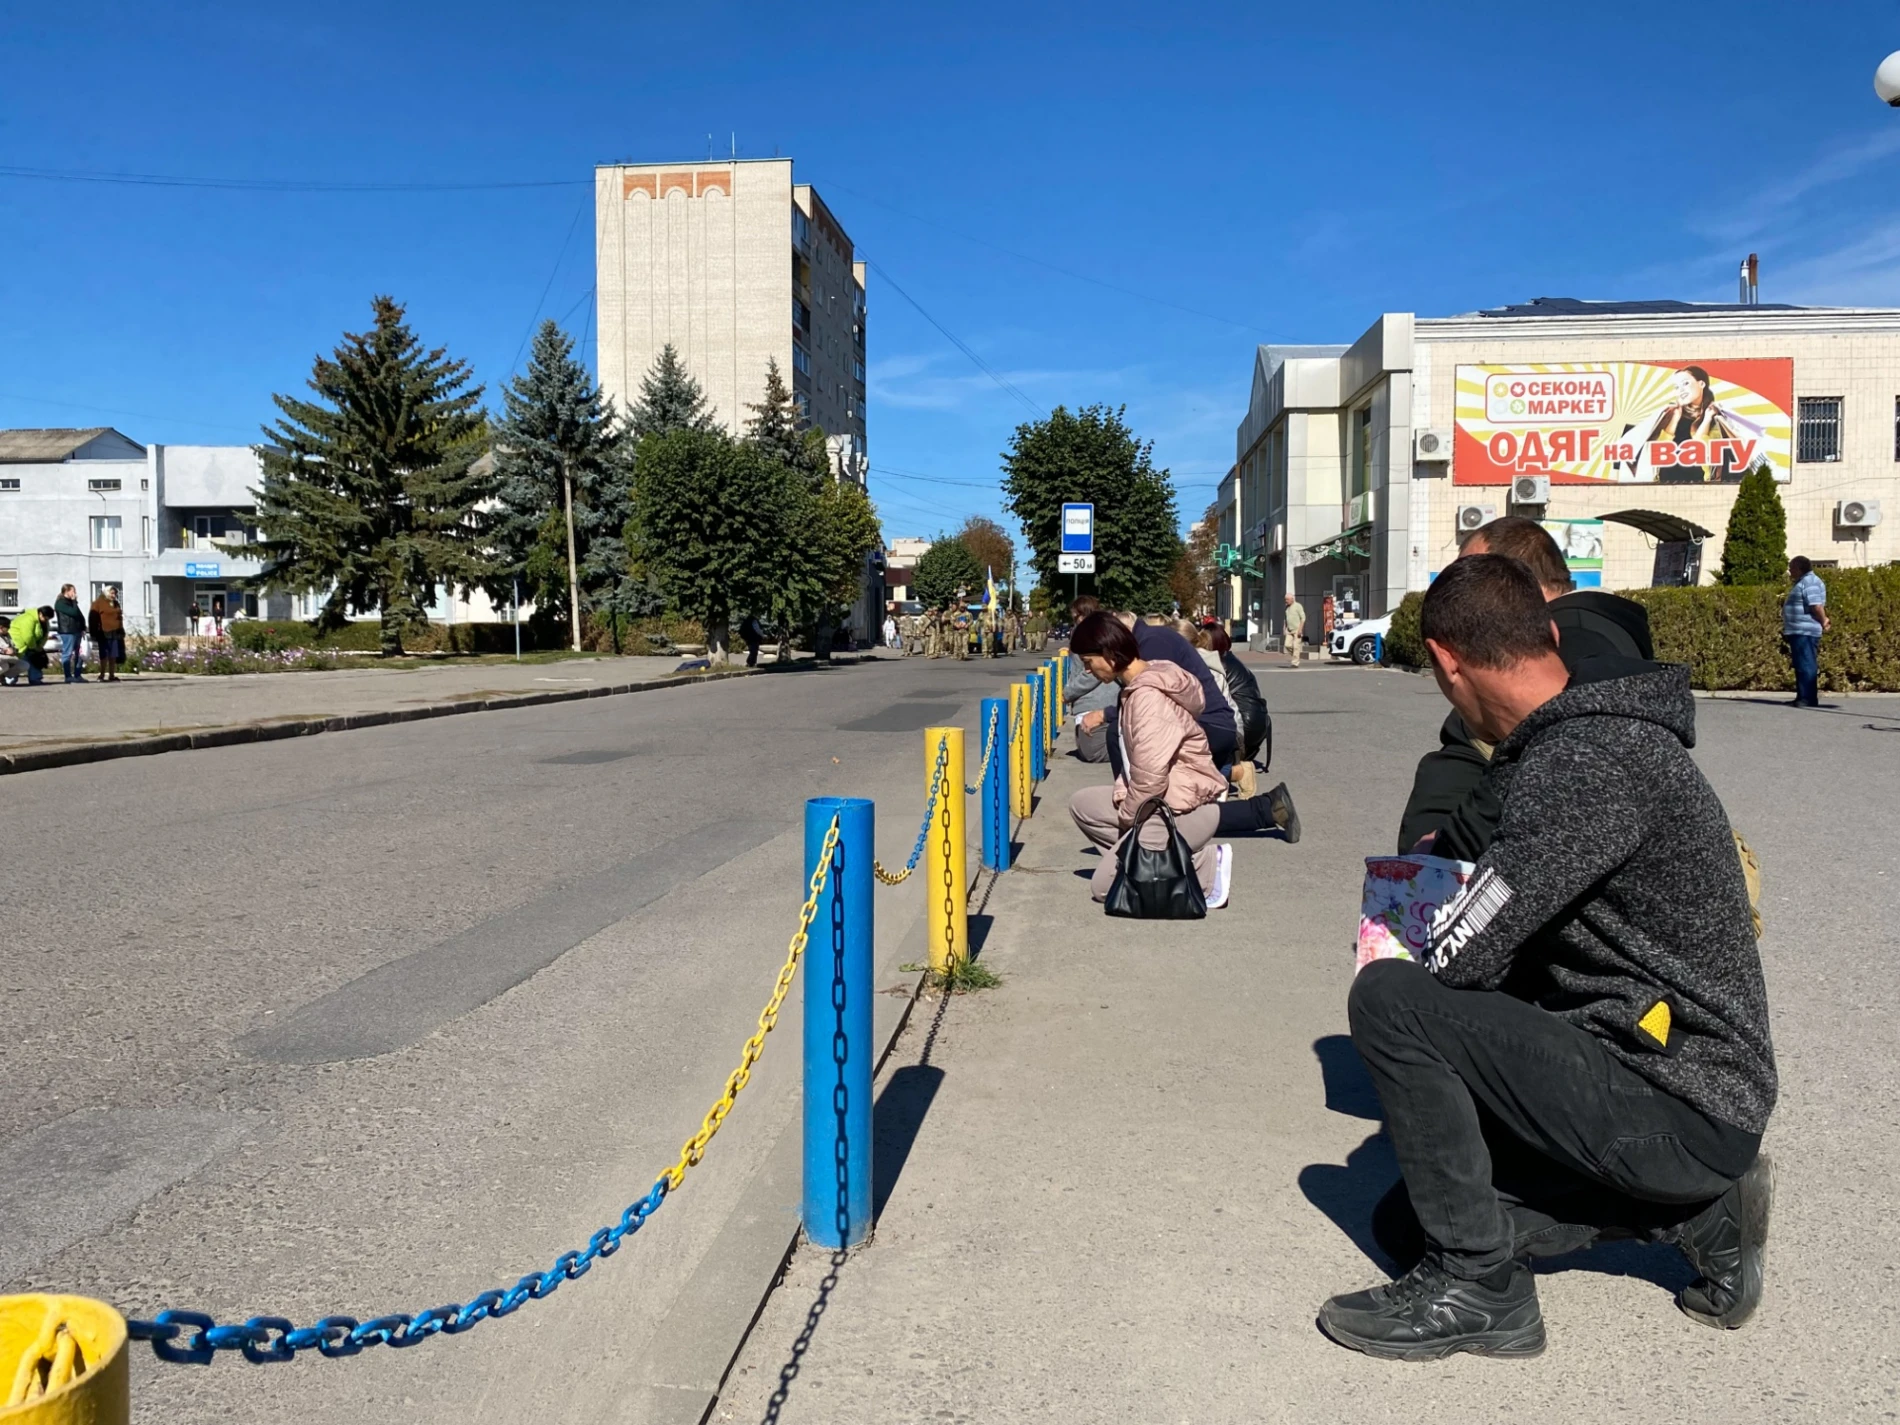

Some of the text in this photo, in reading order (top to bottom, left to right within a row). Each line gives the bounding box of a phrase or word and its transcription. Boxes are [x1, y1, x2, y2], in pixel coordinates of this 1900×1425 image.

[1528, 381, 1606, 397] СЕКОНД
[1528, 399, 1606, 414] МАРКЕТ
[1489, 429, 1599, 469] ОДЯГ
[1604, 443, 1634, 461] на
[1073, 558, 1086, 569] 50
